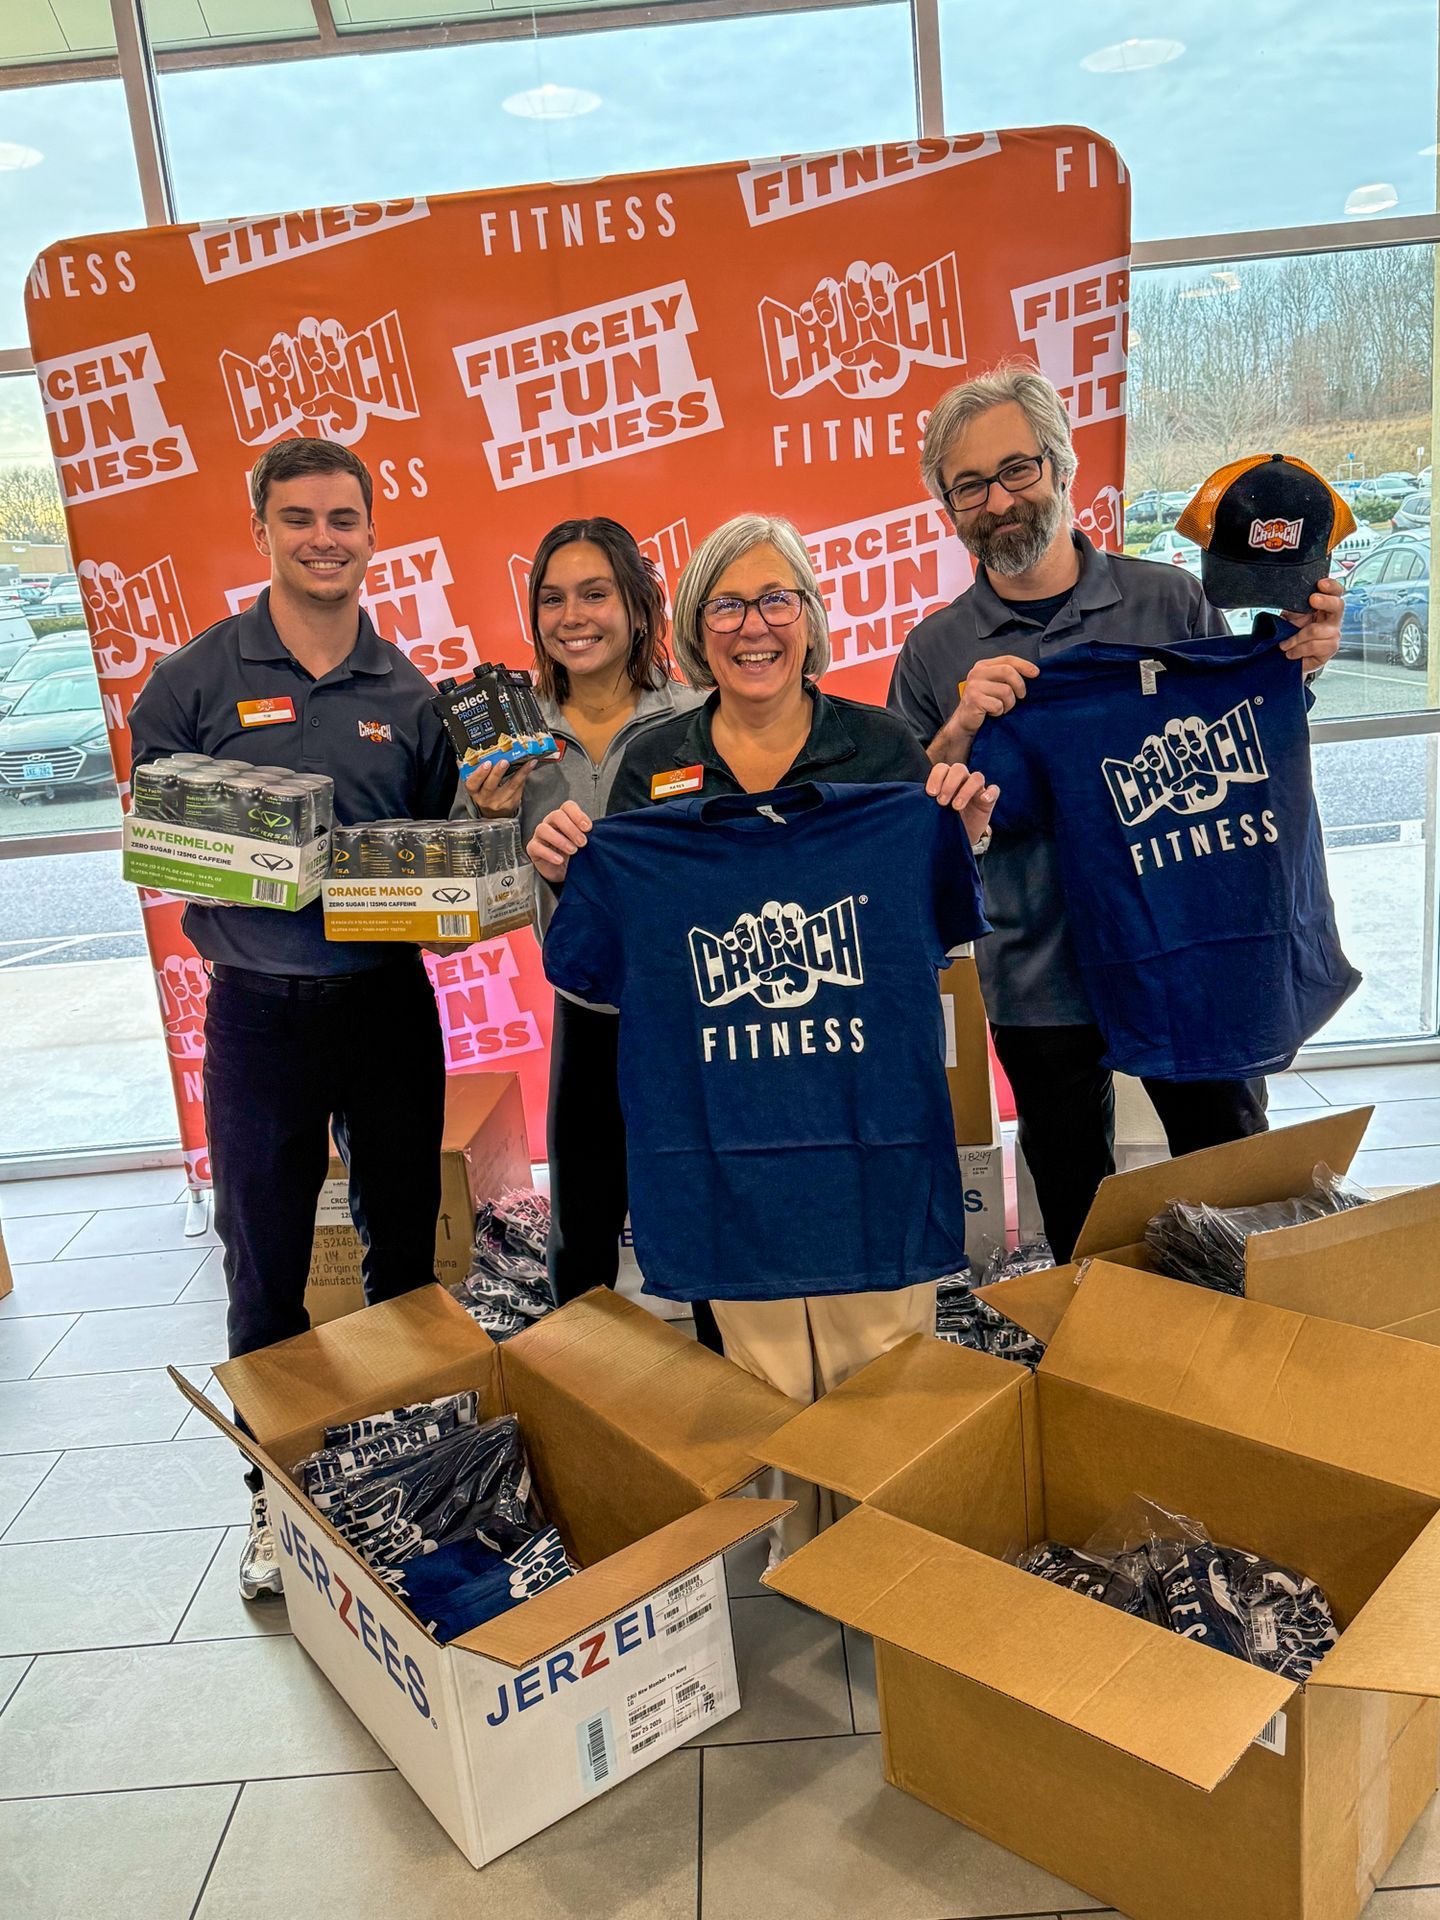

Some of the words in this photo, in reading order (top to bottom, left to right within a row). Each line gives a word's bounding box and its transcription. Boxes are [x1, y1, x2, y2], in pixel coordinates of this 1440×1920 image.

[481, 193, 676, 256] FITNESS
[758, 251, 967, 399] CRUNCH
[466, 293, 683, 389] FIERCELY
[219, 309, 420, 446] CRUNCH
[516, 344, 661, 433] FUN
[498, 391, 709, 481] FITNESS
[1249, 519, 1303, 549] CRUNCH
[451, 690, 489, 714] select
[458, 703, 488, 720] PROTEIN
[357, 720, 392, 743] CRUNCH
[1101, 699, 1269, 826] CRUNCH
[131, 826, 235, 855] WATERMELON
[131, 841, 149, 850] ZERO
[150, 845, 172, 855] SUGAR
[176, 850, 197, 860] 125MG
[198, 854, 232, 866] CAFFEINE
[1130, 810, 1279, 876] FITNESS
[328, 887, 377, 897] ORANGE
[379, 886, 423, 896] MANGO
[688, 895, 864, 1008] CRUNCH
[702, 1017, 865, 1063] FITNESS
[323, 1263, 351, 1276] Origin
[435, 1258, 457, 1268] hina
[279, 1511, 431, 1719] JERZEES
[638, 1687, 648, 1696] New
[648, 1677, 667, 1690] Member
[703, 1699, 715, 1713] 72
[642, 1726, 649, 1734] 25
